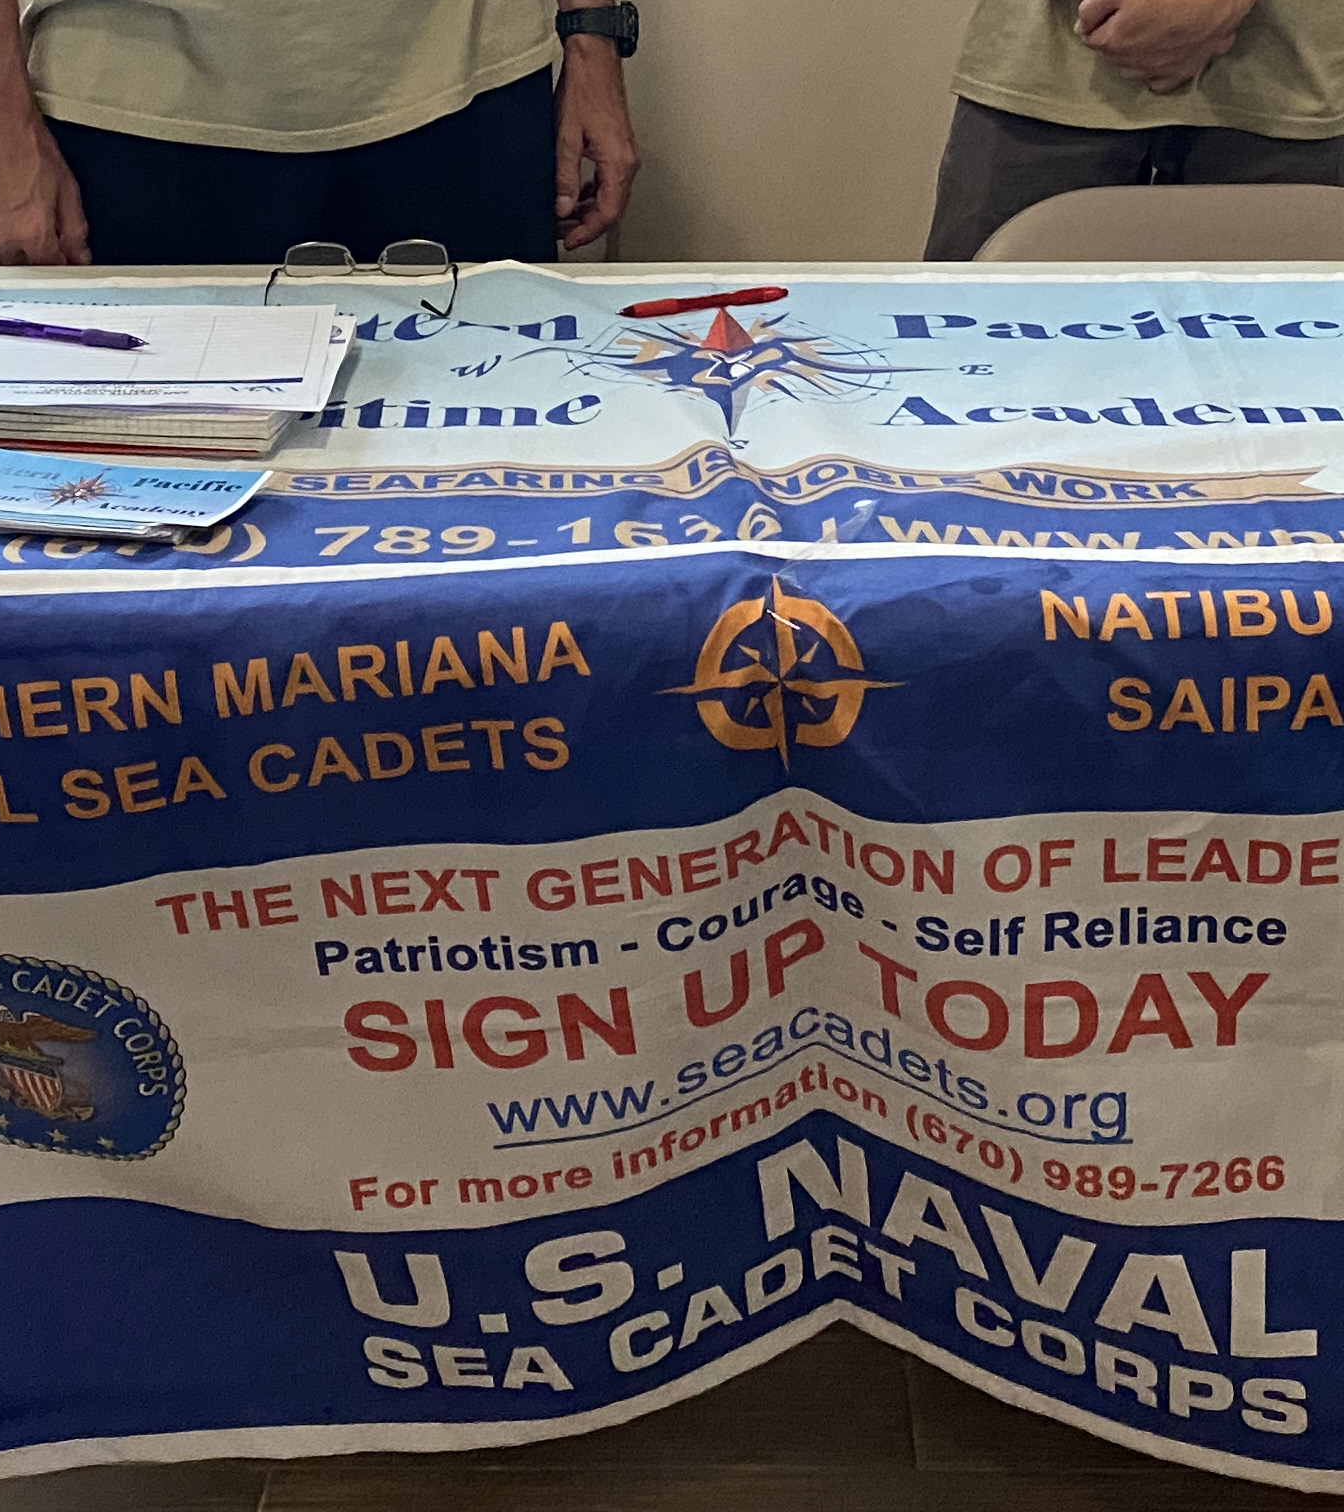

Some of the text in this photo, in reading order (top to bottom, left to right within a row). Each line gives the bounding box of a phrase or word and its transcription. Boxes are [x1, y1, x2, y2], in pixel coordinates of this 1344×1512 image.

[878, 310, 1344, 340] Pacific
[298, 395, 602, 429] itime
[96, 500, 211, 518] Academy
[133, 476, 243, 495] Pacific
[289, 471, 665, 491] SEAFARING
[759, 463, 981, 495] NOBLE
[999, 469, 1209, 501] WORK
[1040, 589, 1334, 641] NATIBU
[212, 621, 591, 719] MARIANA
[61, 756, 227, 820] SEA
[247, 716, 571, 793] CADETS
[155, 885, 299, 935] THE
[320, 869, 499, 920] NEXT
[527, 809, 955, 913] GENERATION
[984, 839, 1076, 893] OF
[315, 935, 598, 976] Patriotism
[656, 872, 864, 952] Courage
[914, 912, 1025, 957] Self
[1044, 907, 1288, 952] Reliance
[11, 970, 122, 1019] CADET
[113, 1017, 169, 1097] CORPS
[344, 918, 1270, 1072] SIGN UP TODAY
[487, 1005, 1129, 1143] www.seacadets.org
[348, 1061, 1286, 1211] For more information (670) 989-7266
[333, 1136, 1318, 1357] U.S. NAVAL
[362, 1225, 1308, 1434] SEA CADET CORPS
